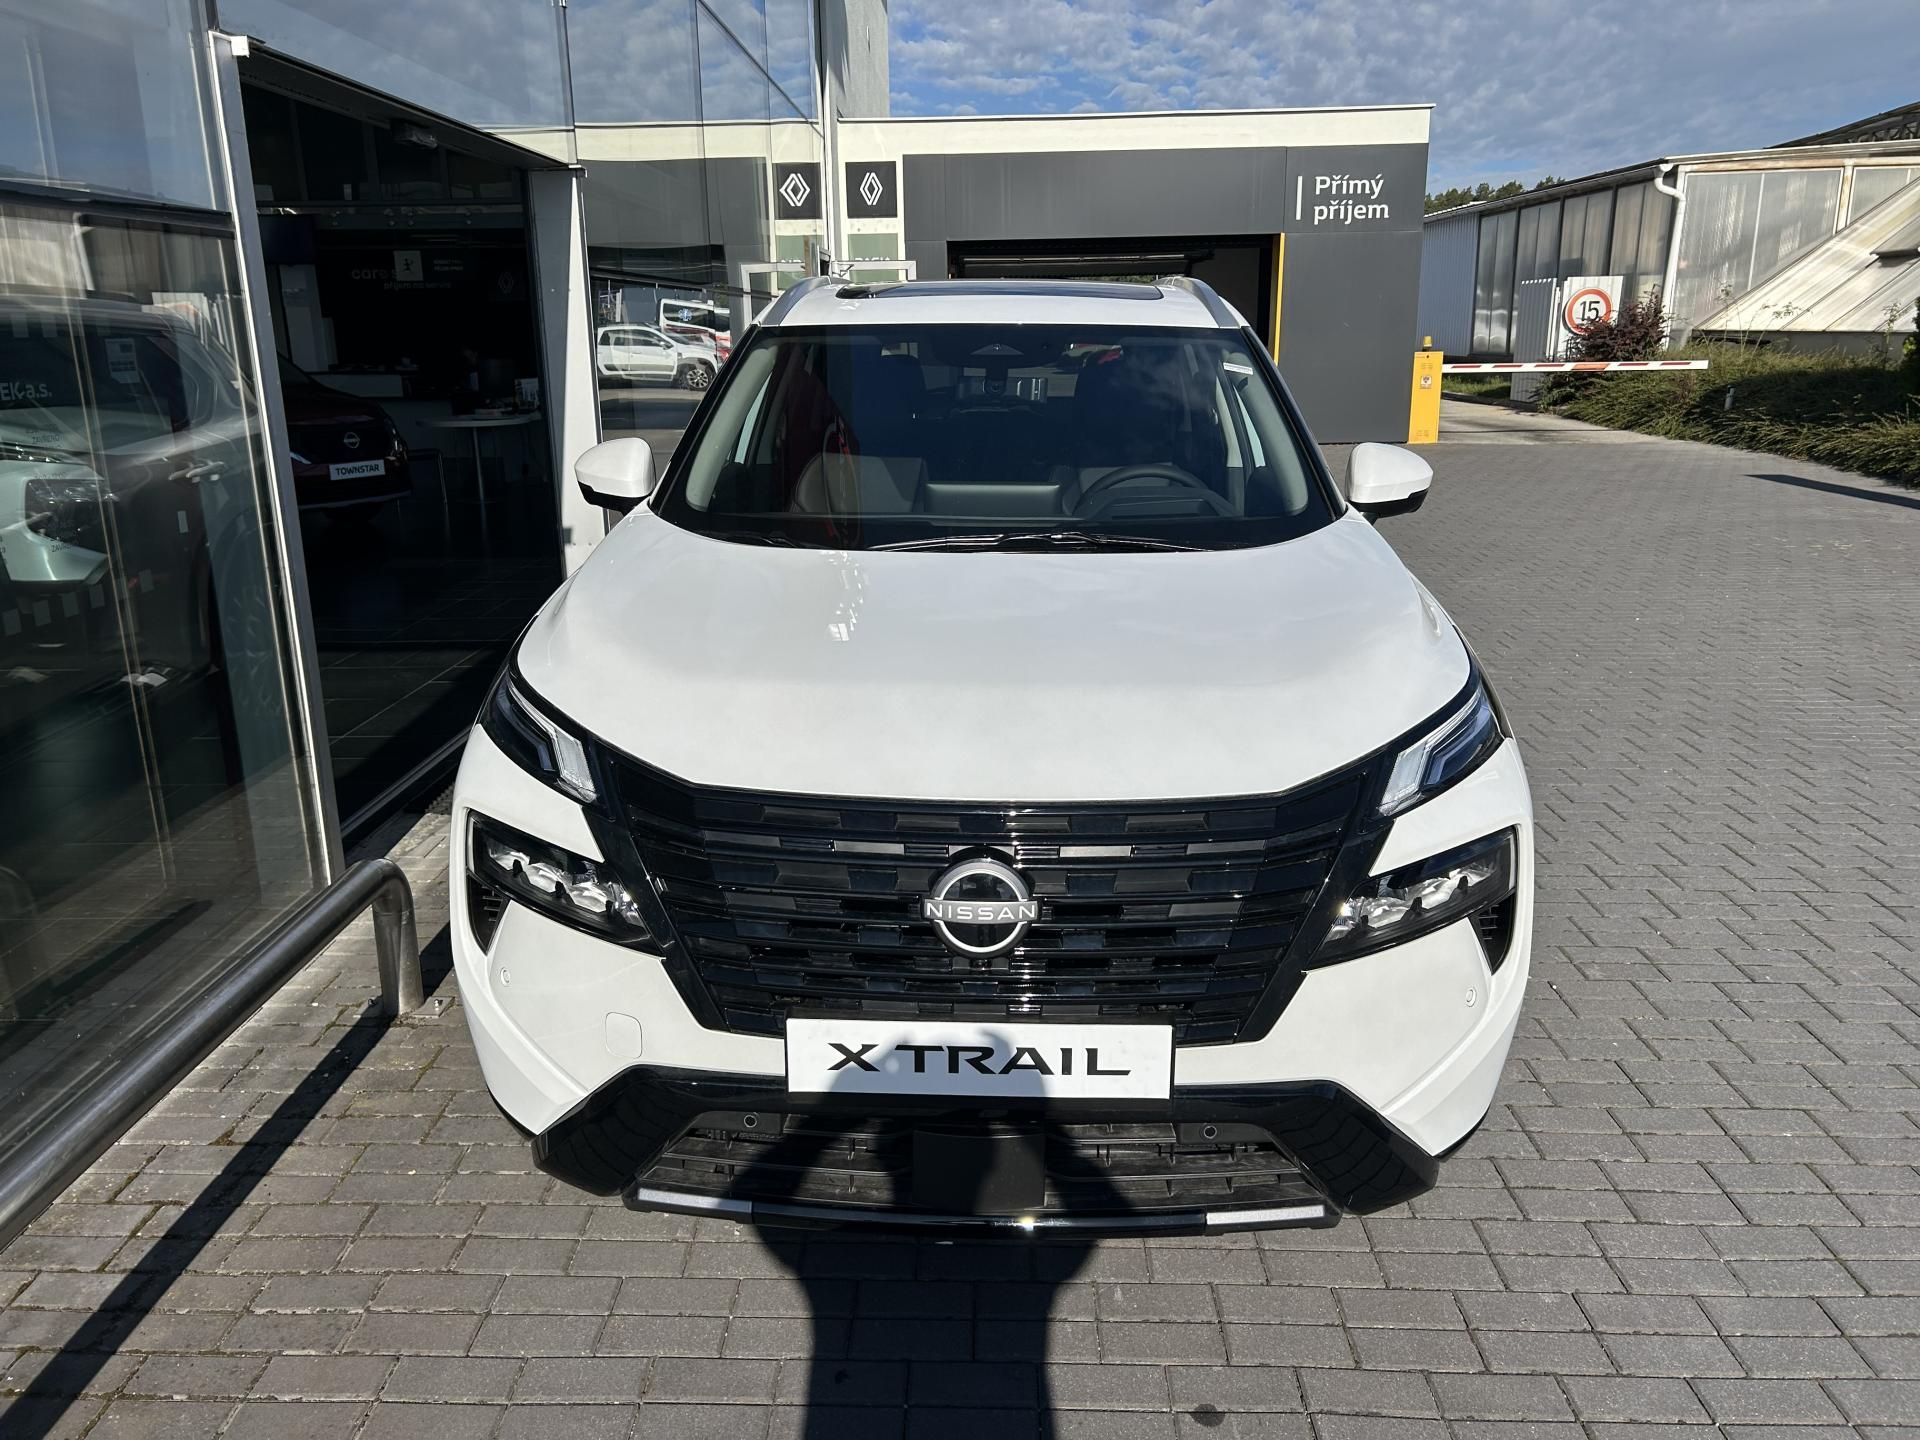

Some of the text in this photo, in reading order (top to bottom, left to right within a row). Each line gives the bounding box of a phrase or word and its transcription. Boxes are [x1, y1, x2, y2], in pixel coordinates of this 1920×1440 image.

[1314, 173, 1384, 200] Přímý
[1313, 199, 1390, 226] příjem
[1580, 300, 1601, 322] 15
[335, 464, 380, 476] TOWNSTAR
[925, 901, 1037, 921] NISSAN
[826, 1042, 1132, 1077] X TRAIL
